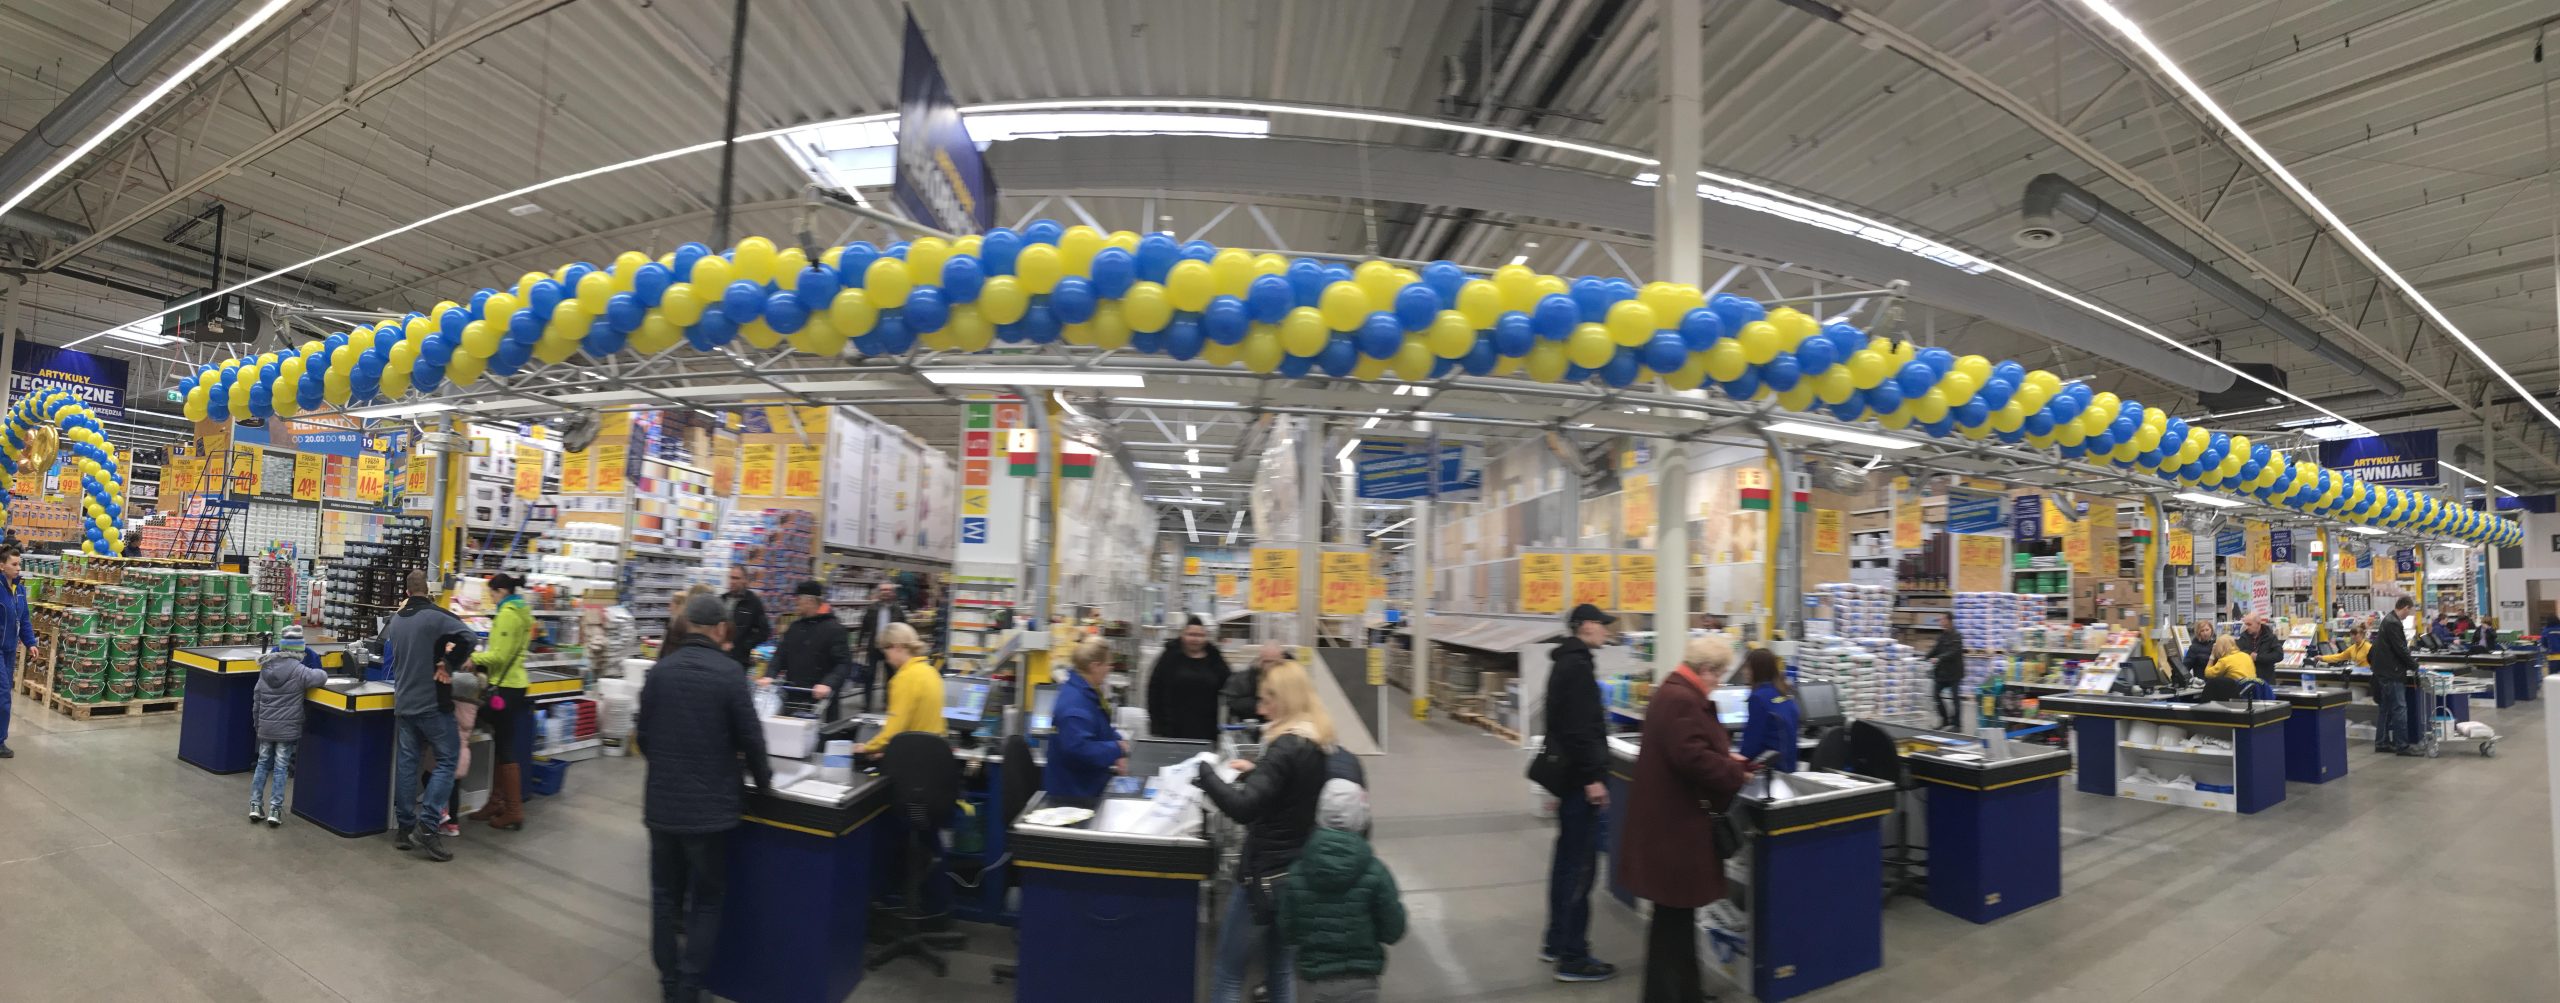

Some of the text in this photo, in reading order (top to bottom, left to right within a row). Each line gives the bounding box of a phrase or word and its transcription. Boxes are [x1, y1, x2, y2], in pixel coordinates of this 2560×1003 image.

[38, 368, 91, 385] ARTYKUŁY
[10, 373, 115, 404] TECHNICZNE
[292, 434, 356, 444] OD 20.02 DO 19.03
[362, 438, 373, 448] 19
[175, 446, 184, 454] 17
[2353, 455, 2400, 467] ARTYKUŁY
[2335, 462, 2423, 481] EWNIANE
